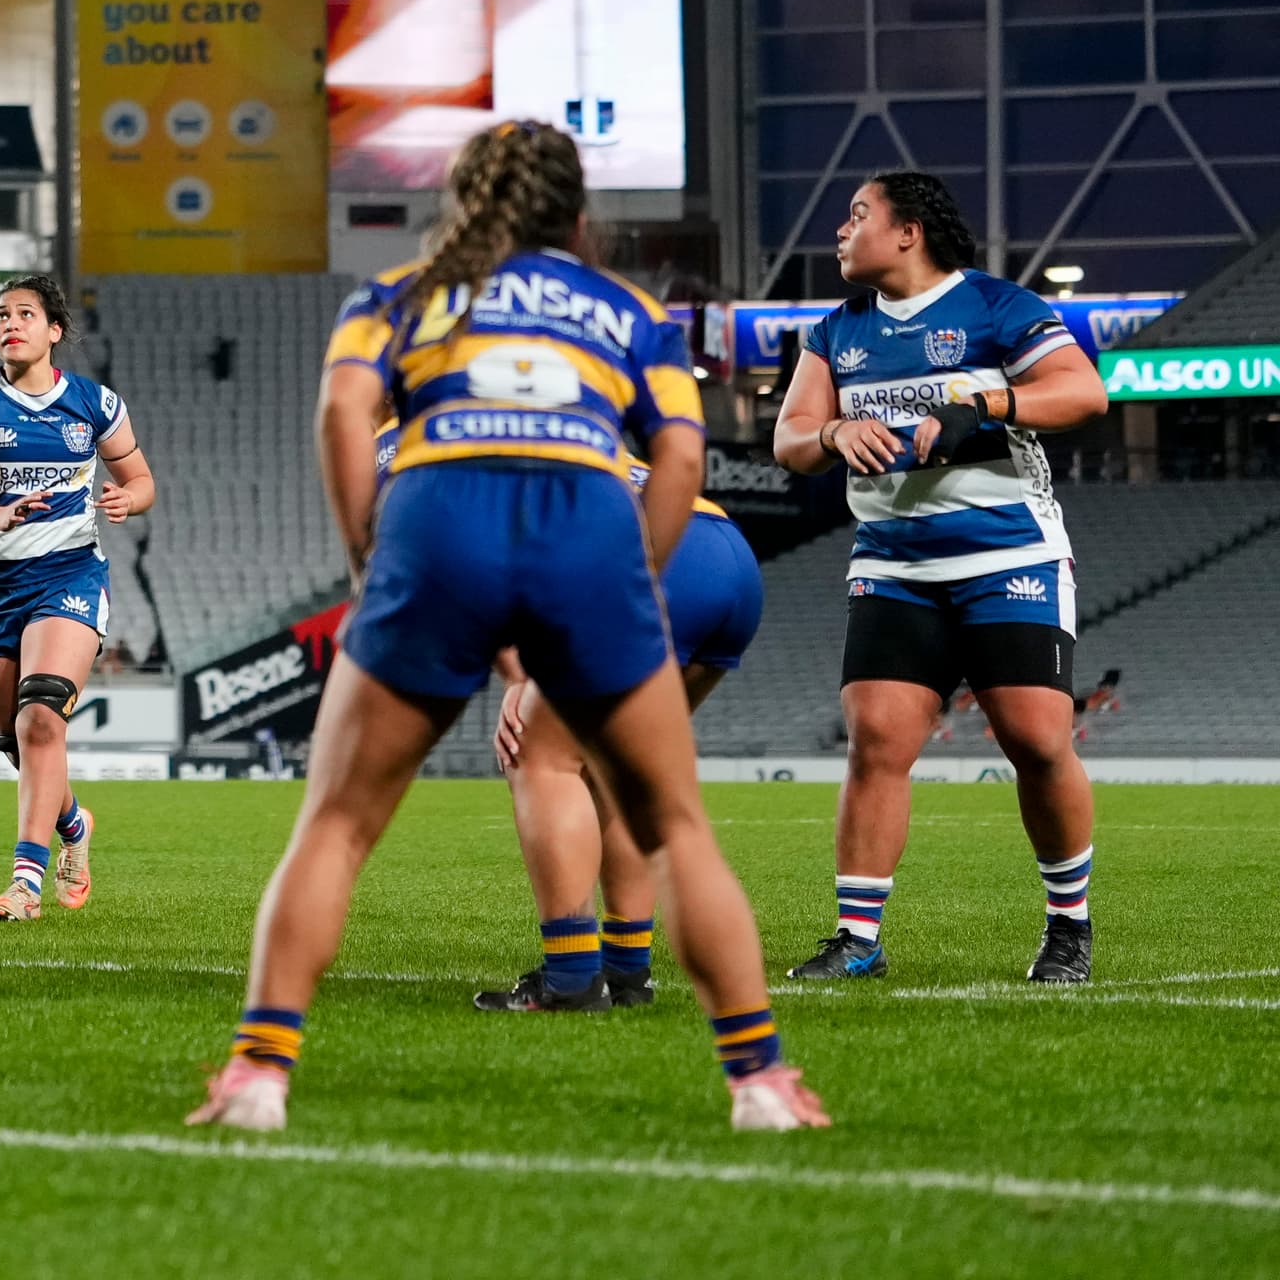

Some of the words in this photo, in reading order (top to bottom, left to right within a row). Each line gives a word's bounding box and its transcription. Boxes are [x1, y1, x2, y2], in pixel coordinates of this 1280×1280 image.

[103, 1, 170, 32] you
[181, 1, 261, 24] care
[102, 36, 211, 65] about
[1104, 358, 1232, 393] ALSCO
[852, 381, 946, 408] BARFOOT
[0, 466, 80, 480] BARFOOT
